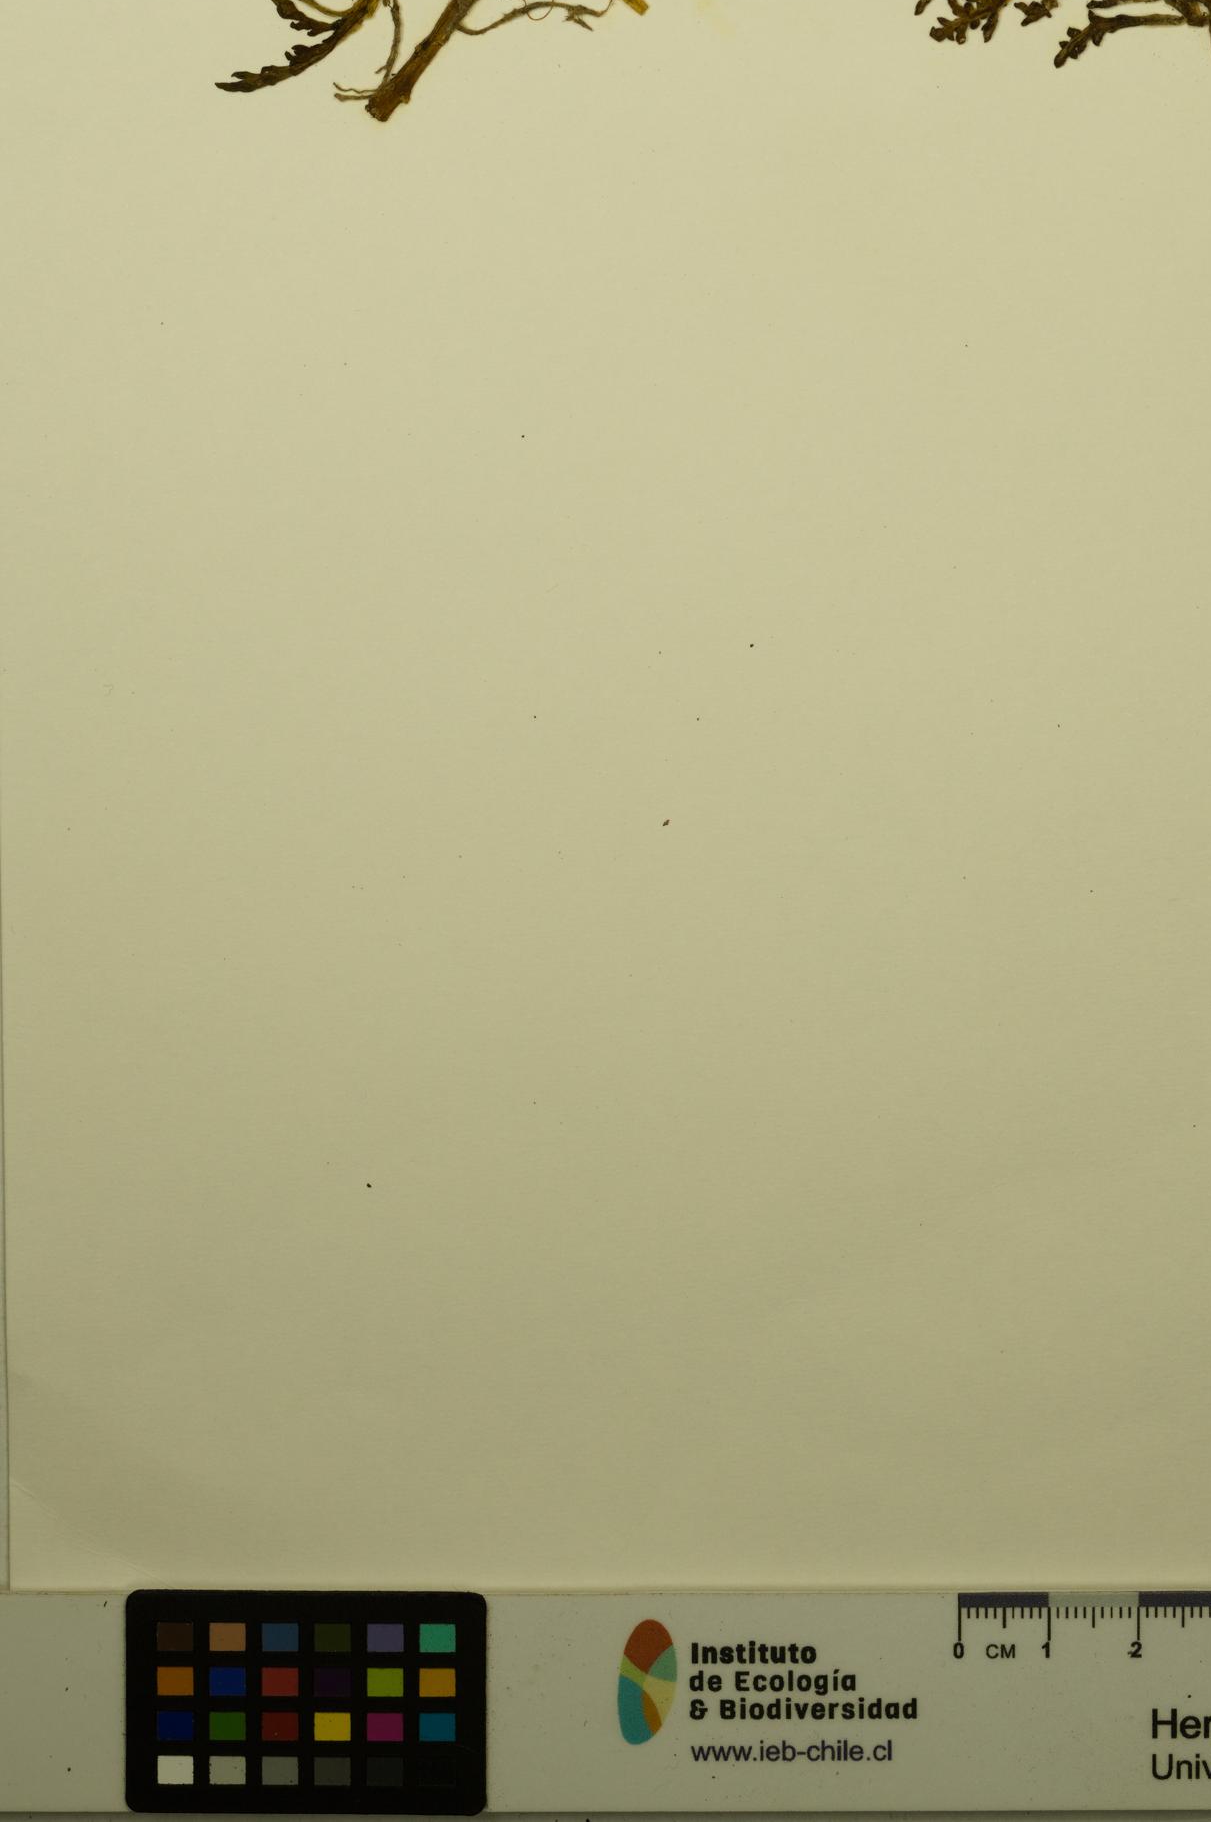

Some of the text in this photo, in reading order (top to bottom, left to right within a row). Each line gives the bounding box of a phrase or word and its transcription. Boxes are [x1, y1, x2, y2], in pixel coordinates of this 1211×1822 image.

[690, 1641, 818, 1664] Instituto
[953, 1643, 965, 1660] 0
[985, 1644, 1016, 1660] CM
[1041, 1641, 1051, 1659] 1
[1130, 1641, 1143, 1658] 2
[688, 1669, 857, 1694] de Ecología
[688, 1697, 918, 1720] & Biodiversidad
[690, 1739, 893, 1762] www.ieb-chile.cl
